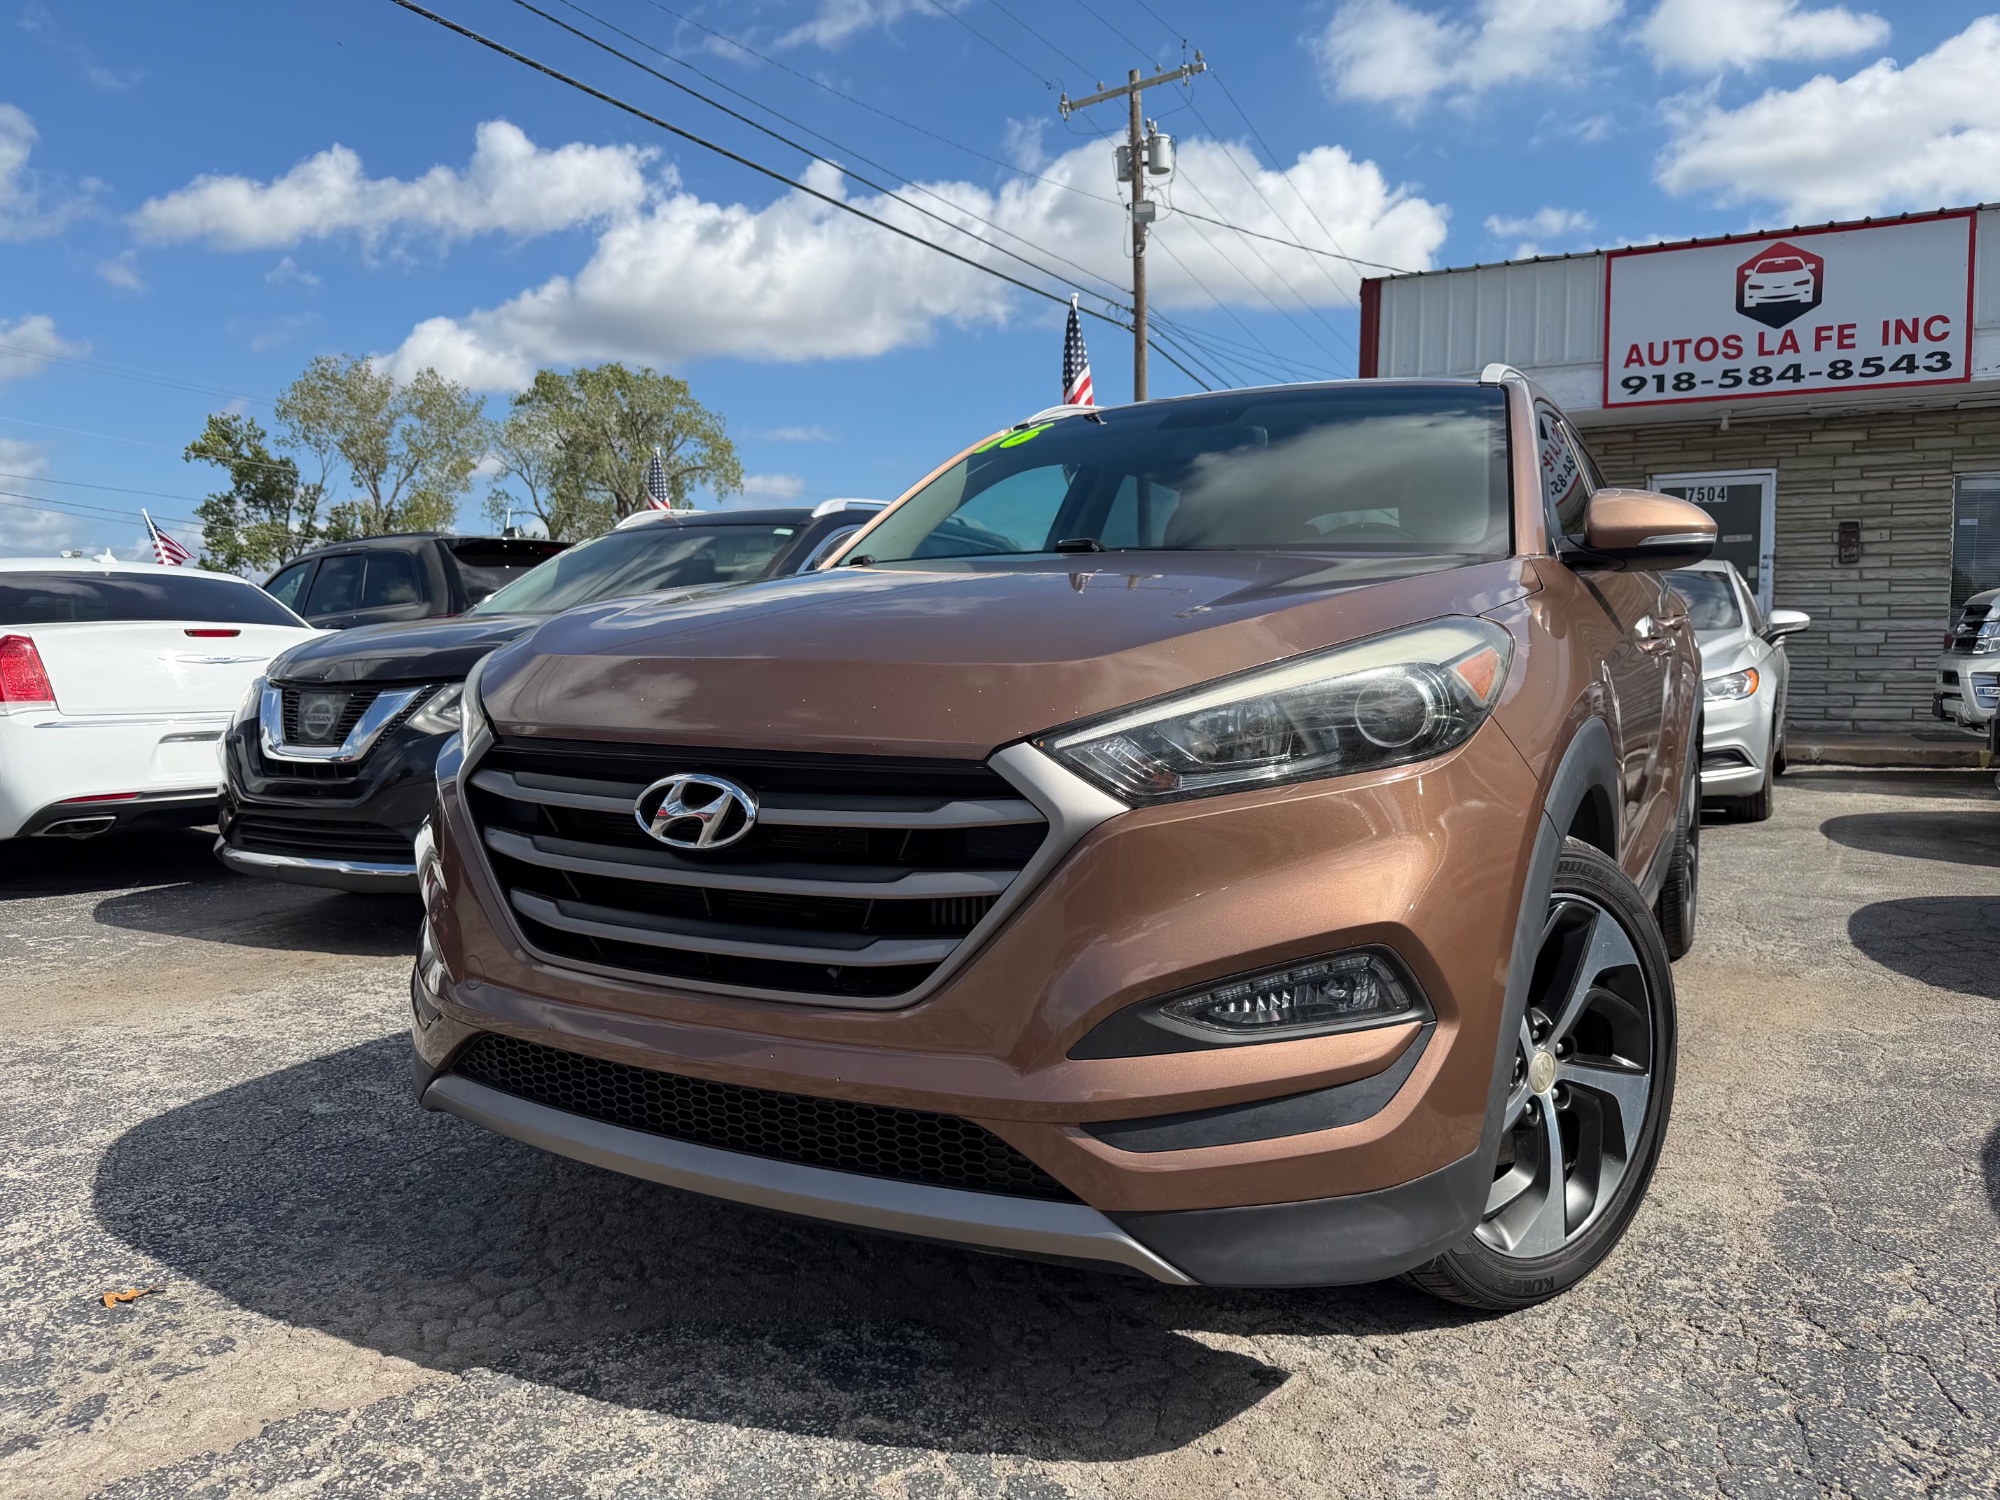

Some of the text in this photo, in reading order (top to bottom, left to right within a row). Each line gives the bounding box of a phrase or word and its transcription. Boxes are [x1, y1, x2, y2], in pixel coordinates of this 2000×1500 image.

[1623, 314, 1951, 369] AUTOS LA FE INC
[1620, 350, 1953, 395] 918-584-8543
[1687, 486, 1726, 502] 7504
[305, 714, 332, 722] NISSAN
